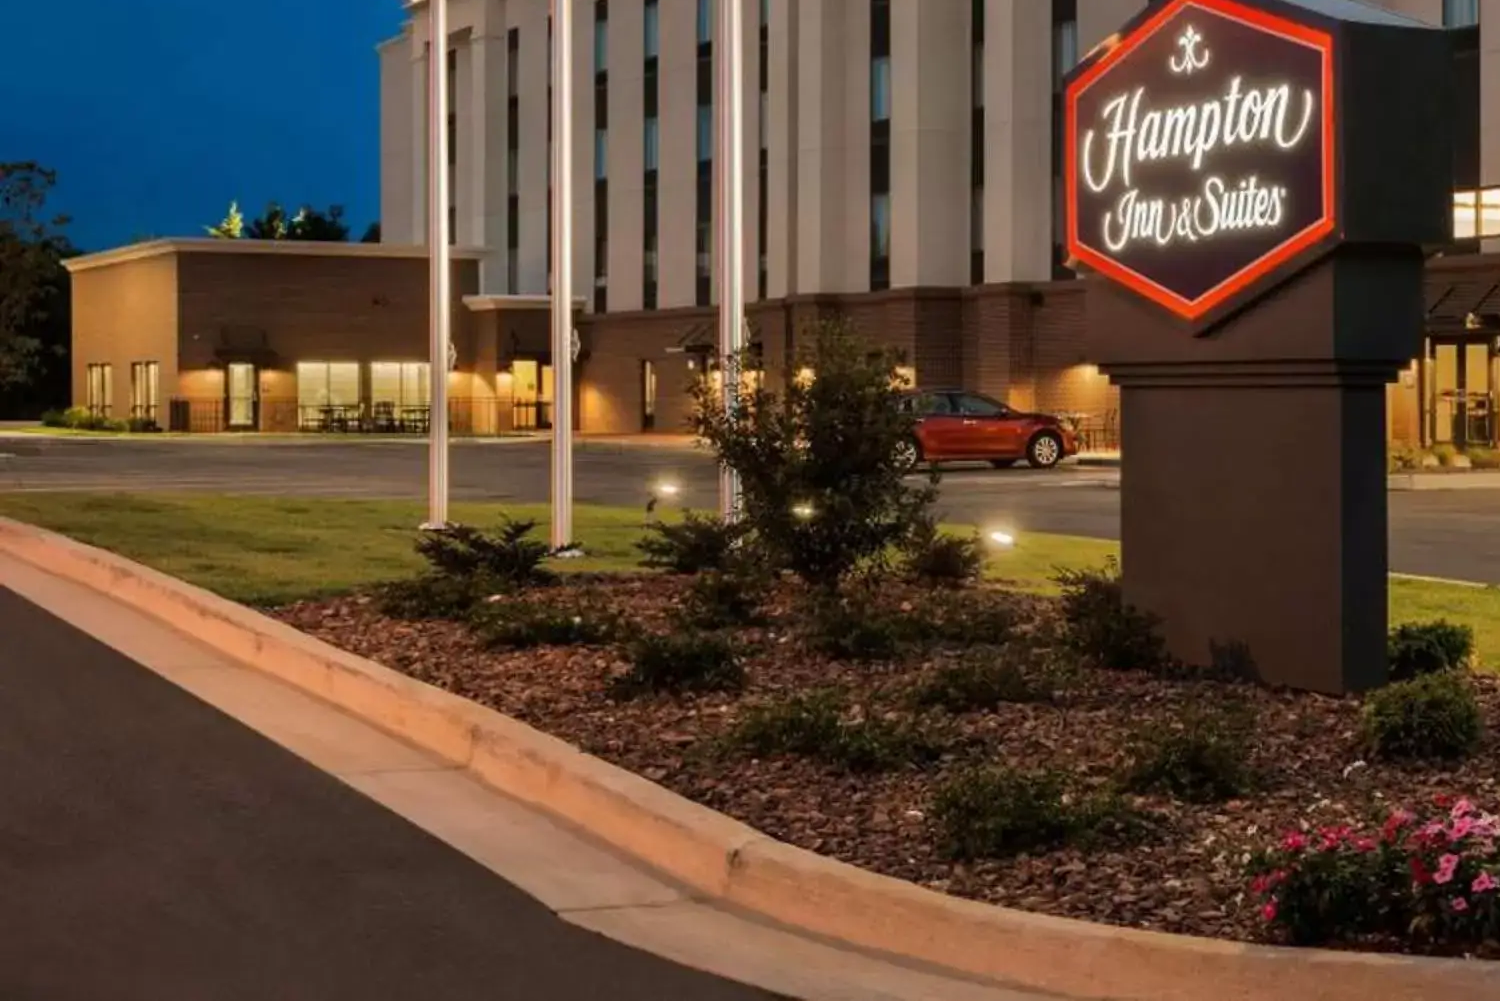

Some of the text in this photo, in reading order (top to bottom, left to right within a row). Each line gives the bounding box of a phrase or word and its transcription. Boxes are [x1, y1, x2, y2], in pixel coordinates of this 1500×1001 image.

[1083, 75, 1313, 192] Hampton
[1104, 176, 1283, 251] Inn & Suites
